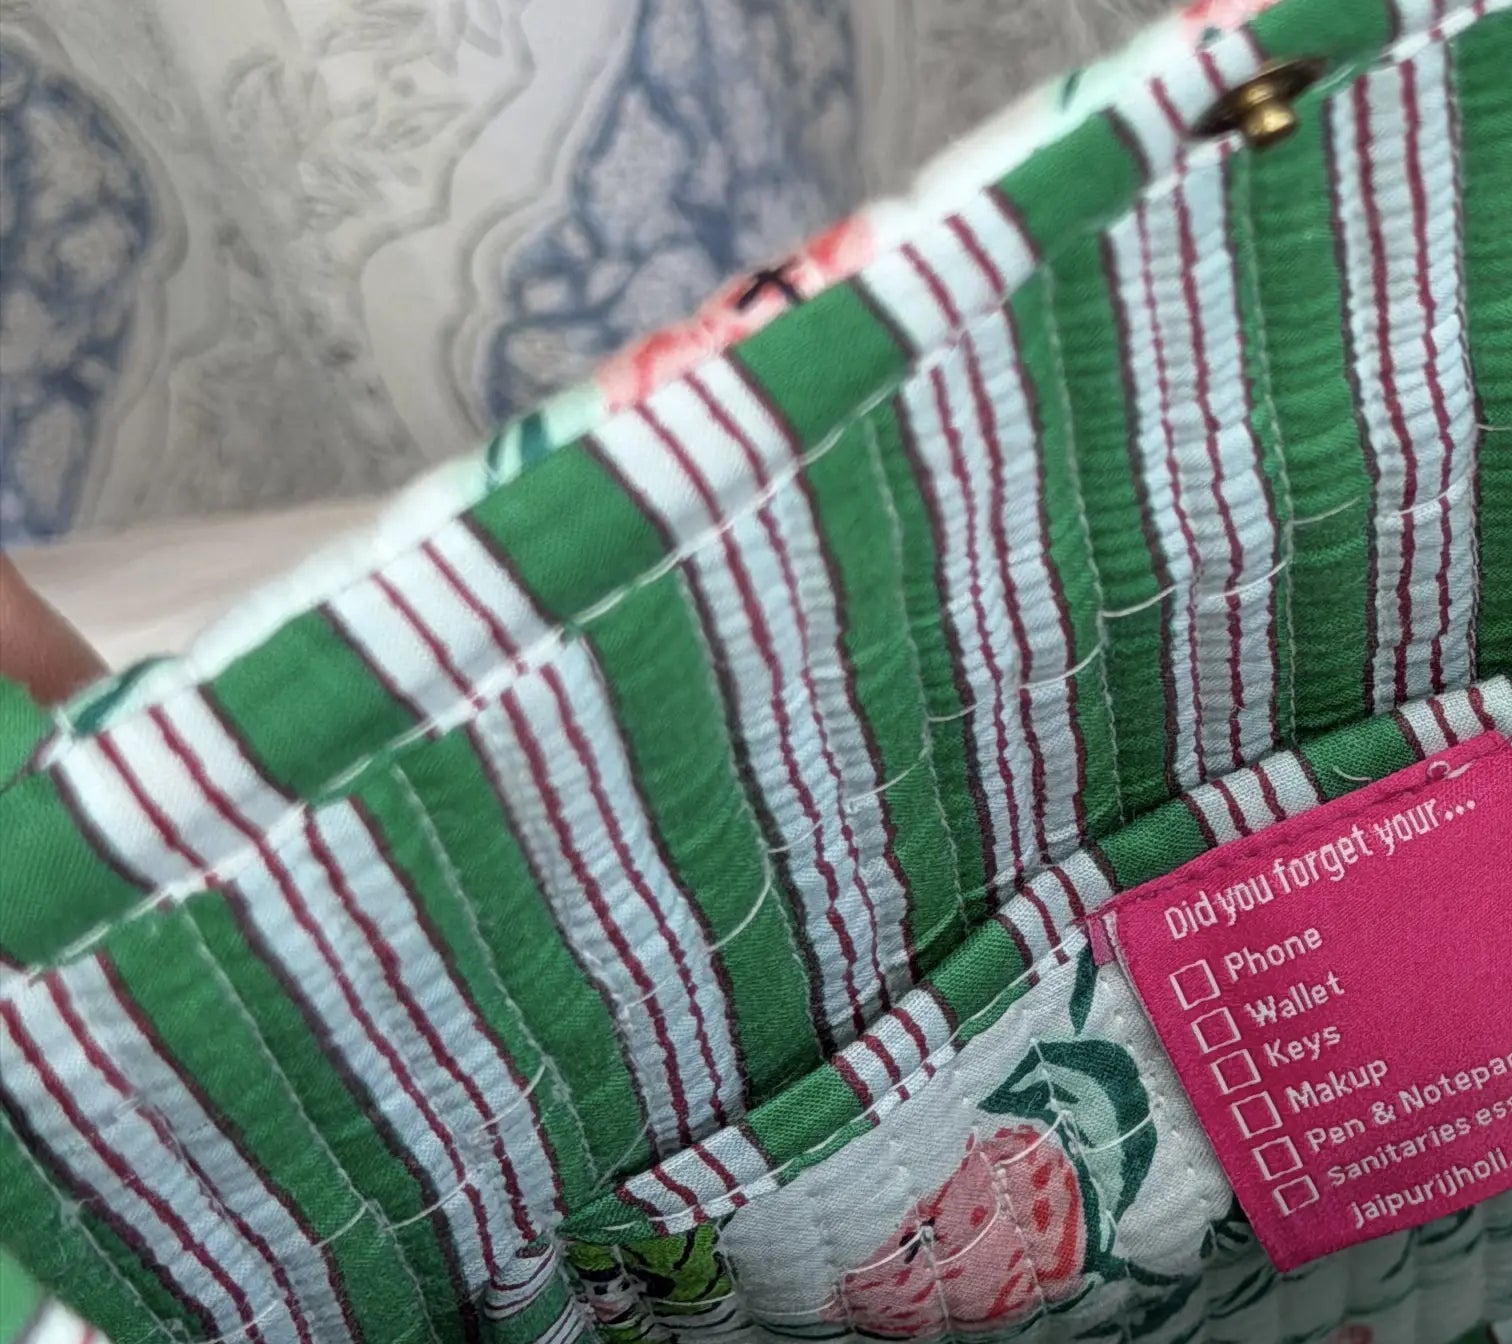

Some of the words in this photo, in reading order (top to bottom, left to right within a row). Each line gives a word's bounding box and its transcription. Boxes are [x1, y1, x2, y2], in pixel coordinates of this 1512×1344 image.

[1165, 891, 1217, 940] Did
[1216, 876, 1273, 926] you
[1273, 824, 1374, 894] forget
[1224, 927, 1323, 982] Phone
[1244, 970, 1345, 1027] Wallet
[1263, 1025, 1342, 1068] Keys
[1285, 1059, 1389, 1114] Makup
[1305, 1115, 1366, 1153] Pen
[1370, 1100, 1397, 1126] &
[1327, 1115, 1472, 1187] Sanitaries
